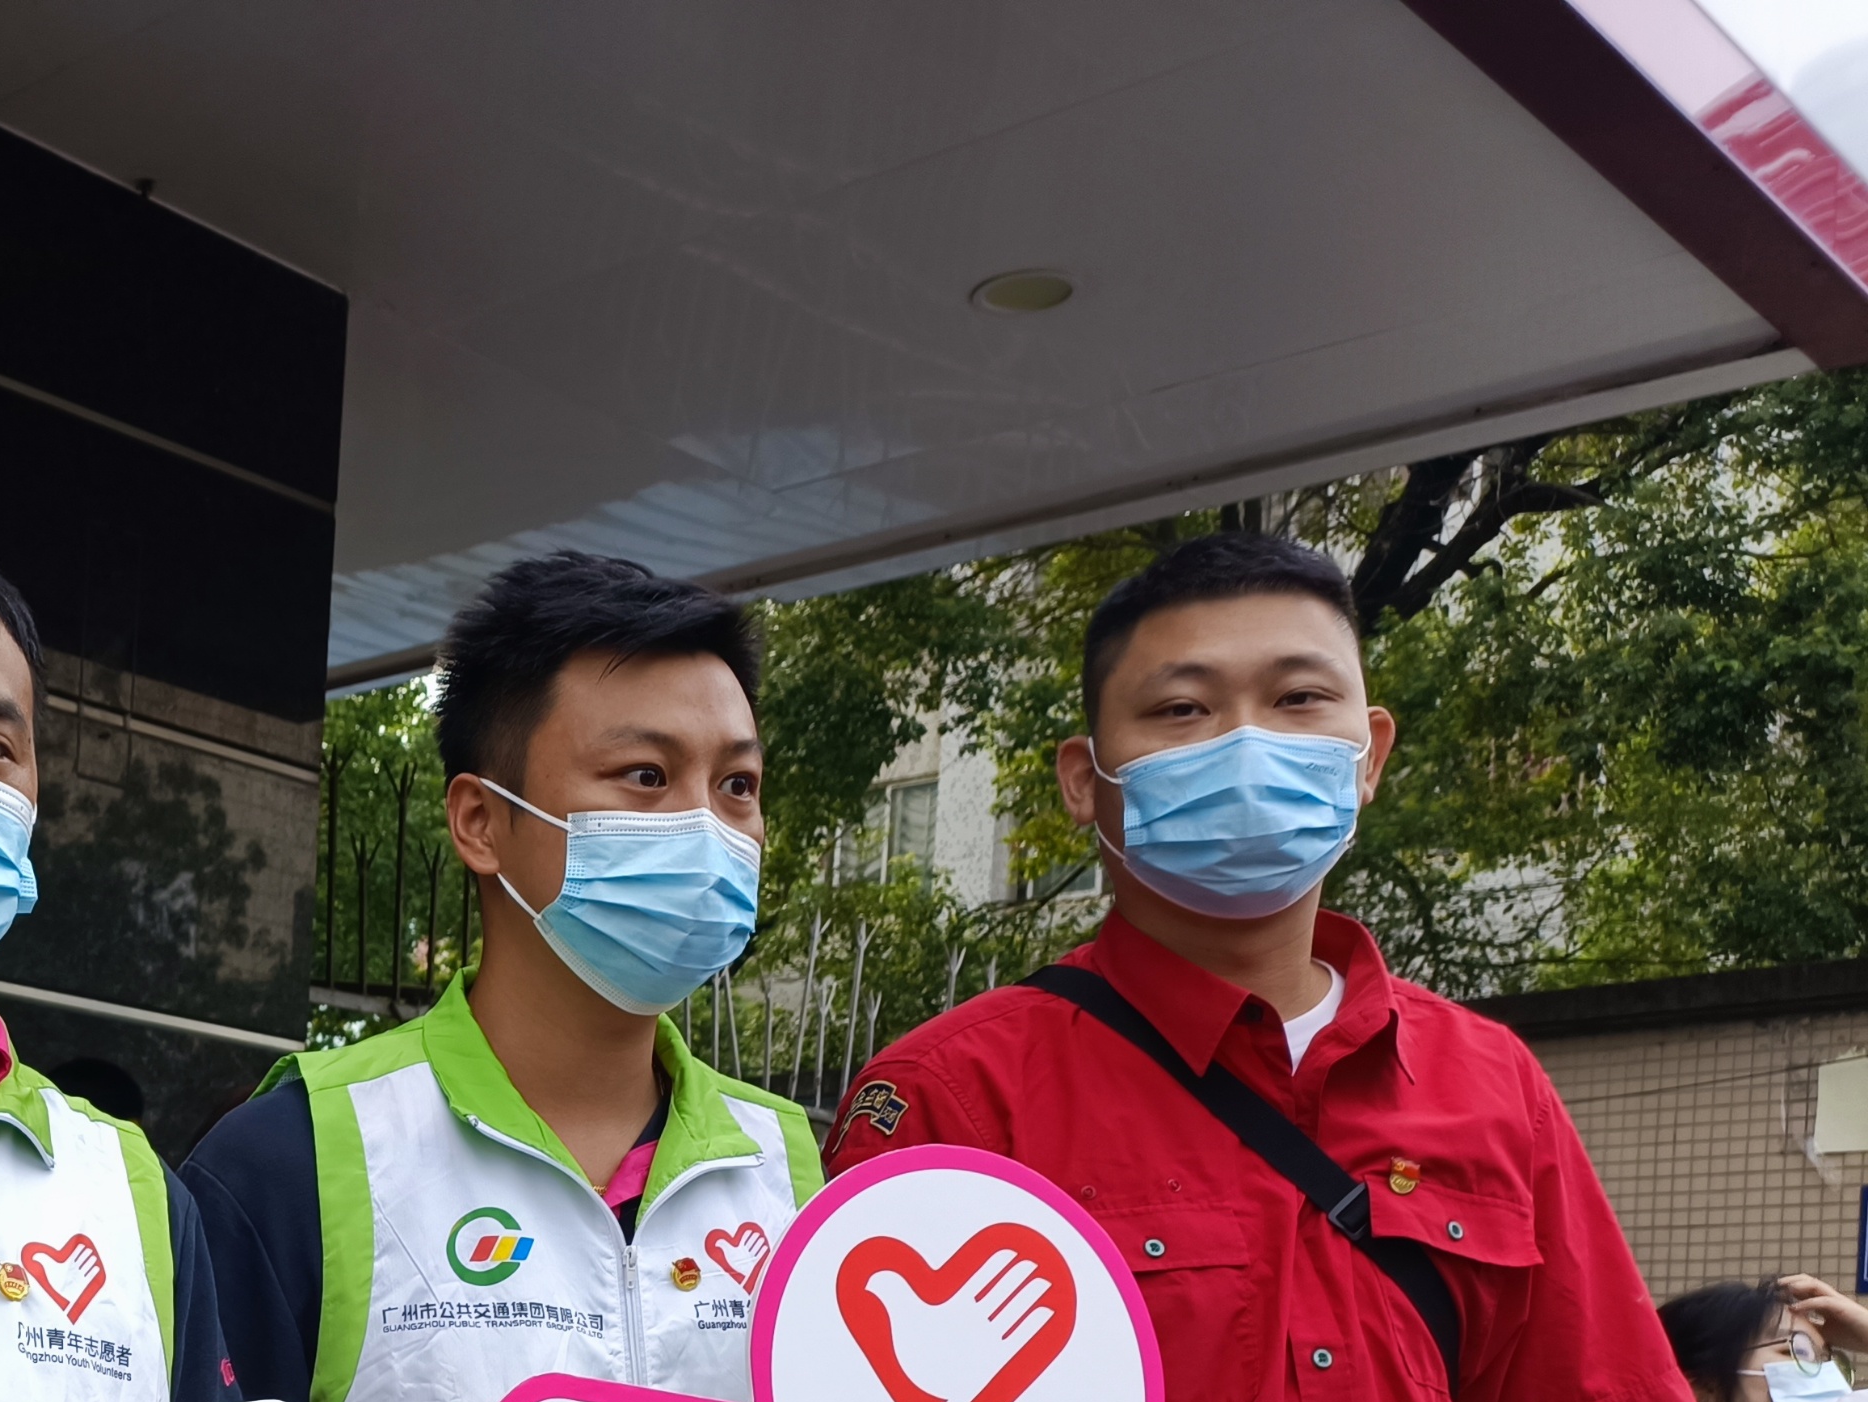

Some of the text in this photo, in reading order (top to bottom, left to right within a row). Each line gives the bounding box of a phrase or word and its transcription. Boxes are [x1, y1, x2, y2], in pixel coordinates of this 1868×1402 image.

[382, 1301, 604, 1332] 广州市公共交通集团有限公司
[693, 1298, 751, 1319] 广州青
[382, 1319, 446, 1333] GUANGZHOU
[448, 1319, 482, 1329] PUBLIC
[485, 1319, 543, 1328] TRANSPORT
[545, 1320, 574, 1332] GROUP
[697, 1319, 748, 1331] Guangzhou
[17, 1321, 133, 1367] 广州青年志愿者
[65, 1353, 91, 1369] Youth
[91, 1360, 132, 1382] Volunteers
